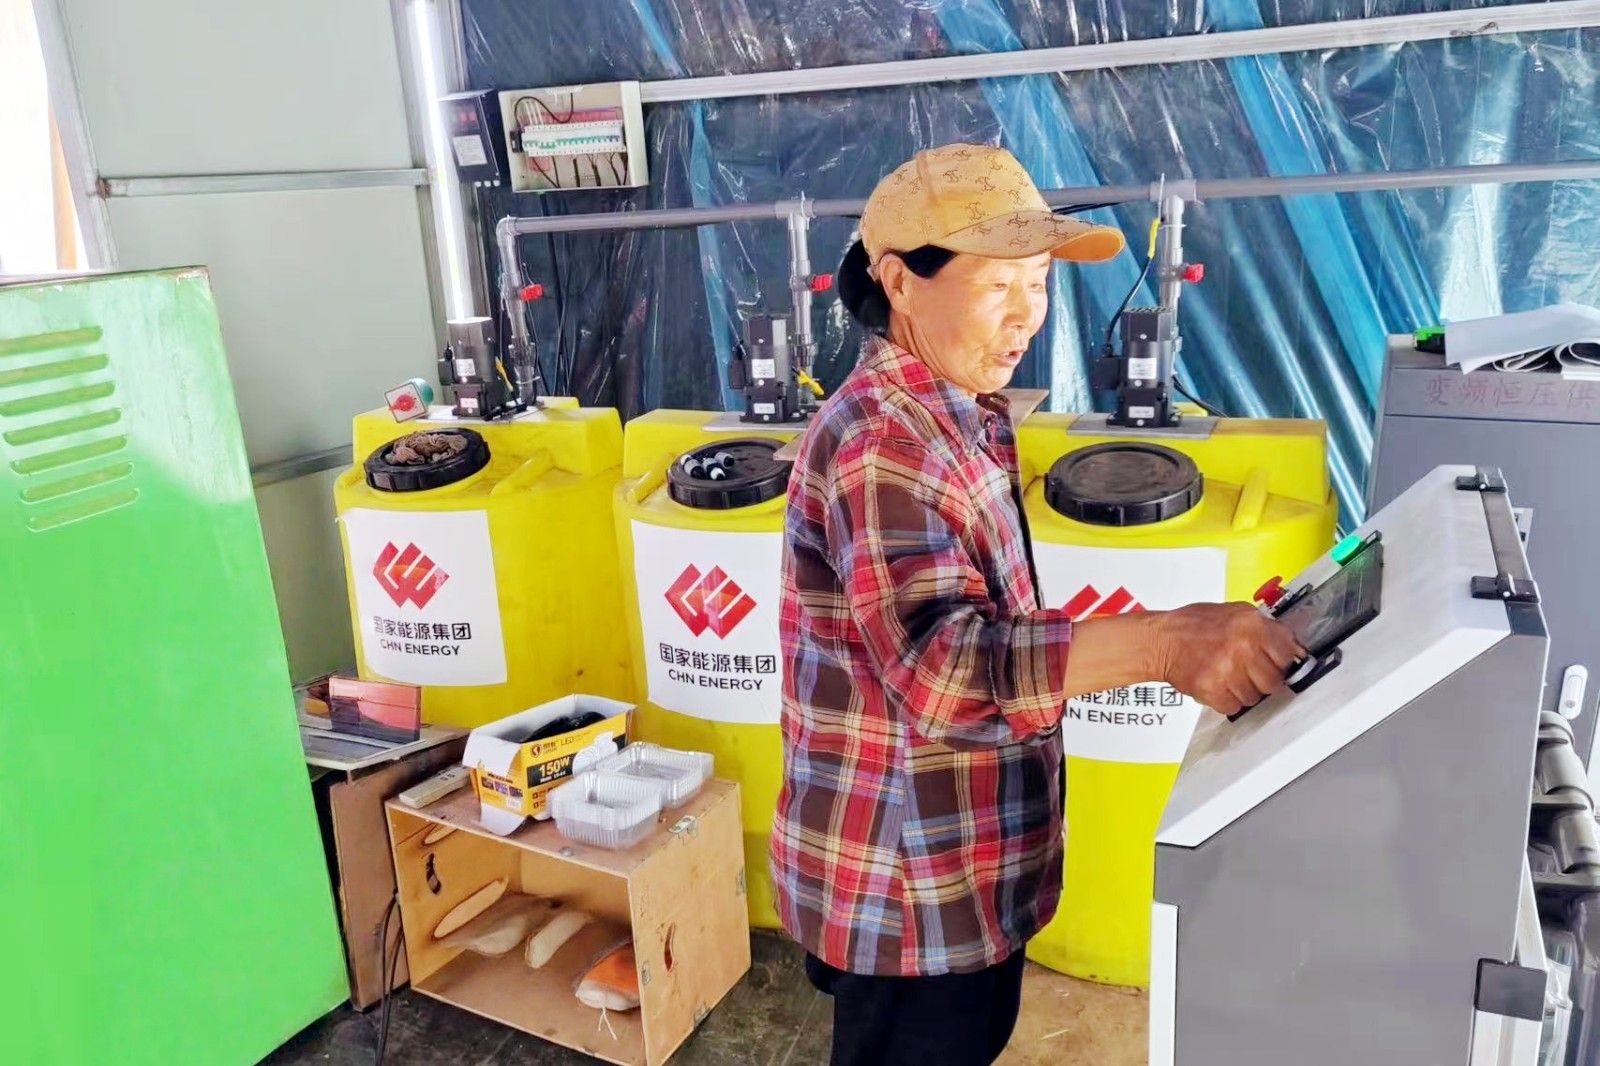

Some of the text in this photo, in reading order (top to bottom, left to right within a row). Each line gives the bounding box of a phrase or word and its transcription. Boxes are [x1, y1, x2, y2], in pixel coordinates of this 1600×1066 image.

[373, 615, 472, 640] 国家能源集团
[380, 639, 460, 656] CHN ENERGY
[659, 642, 776, 674] 国家能源集团
[668, 669, 763, 691] CHN ENERGY
[1074, 686, 1183, 707] 能源集团
[1087, 709, 1167, 726] ENERGY
[539, 756, 570, 778] 150W
